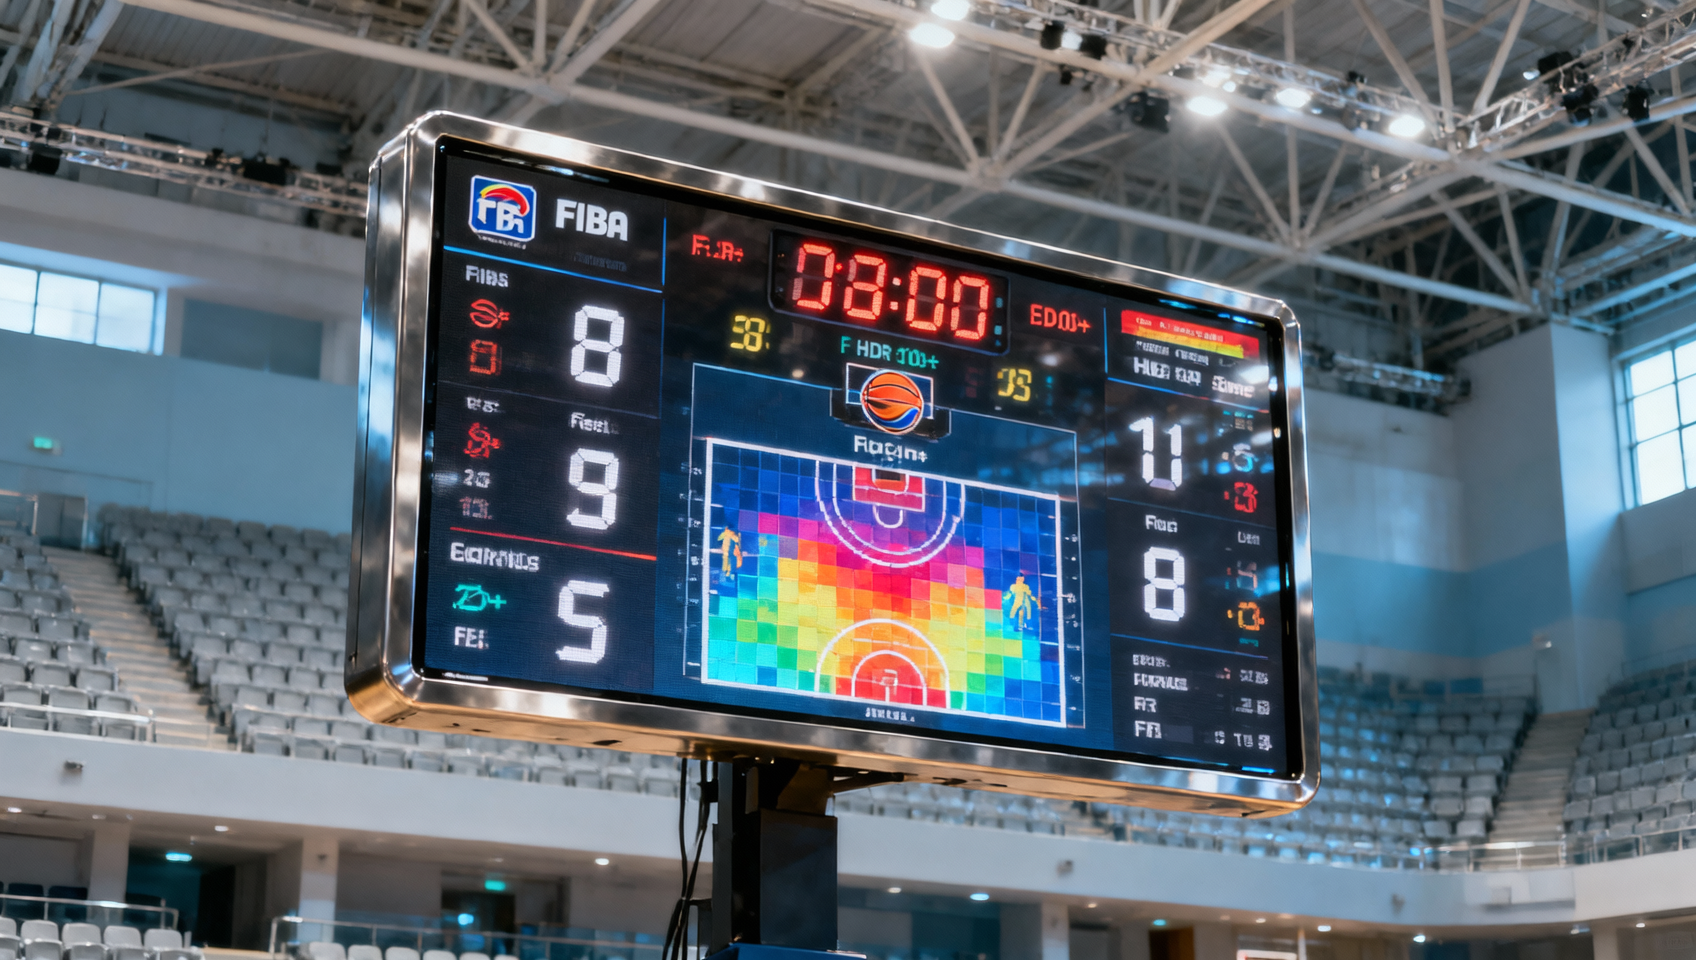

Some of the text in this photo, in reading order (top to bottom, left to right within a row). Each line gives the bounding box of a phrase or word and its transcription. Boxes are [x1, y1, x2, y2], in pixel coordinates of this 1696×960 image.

[555, 198, 629, 241] FIBA
[570, 305, 625, 387] 8
[566, 448, 620, 530] 9
[555, 579, 610, 664] 5
[1143, 546, 1186, 622] 8
